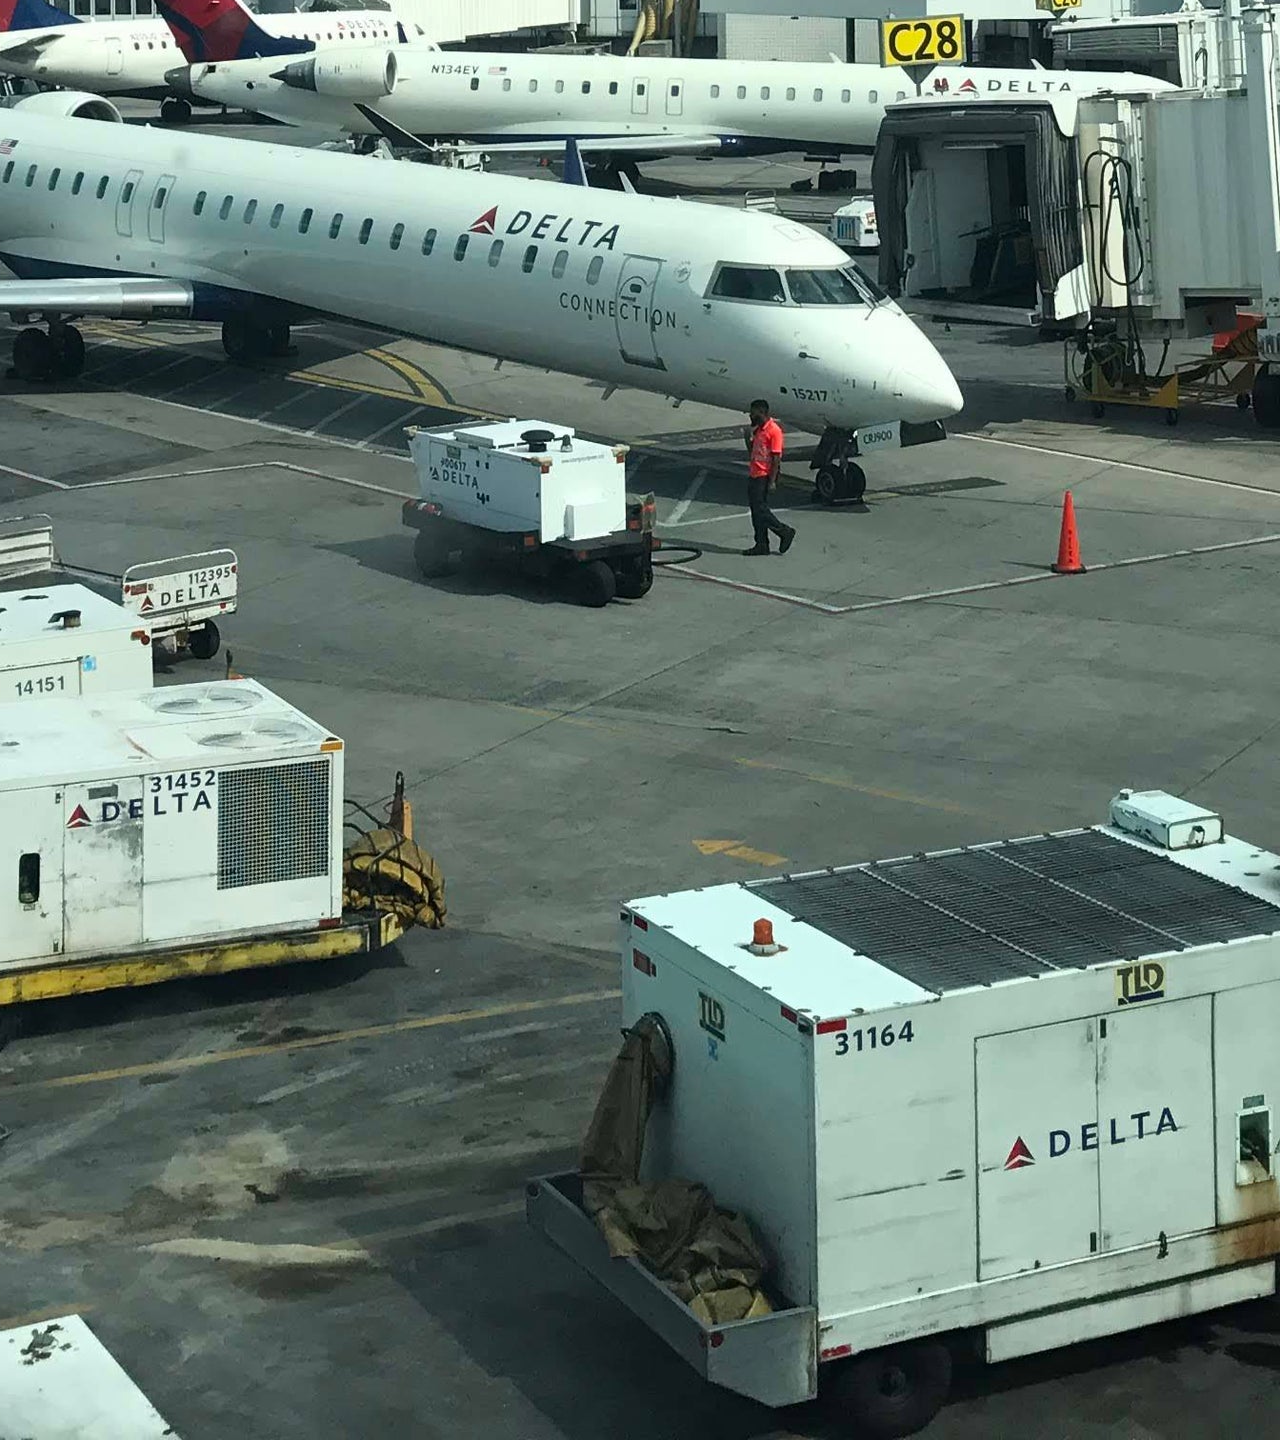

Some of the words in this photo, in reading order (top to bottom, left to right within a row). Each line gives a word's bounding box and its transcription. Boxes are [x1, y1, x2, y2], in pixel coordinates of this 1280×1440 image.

[888, 20, 958, 61] C28
[431, 64, 480, 75] N134EV
[988, 79, 1072, 93] DELTA
[505, 210, 620, 250] DELTA
[559, 292, 677, 329] CONNECTION
[792, 388, 828, 402] 15217
[442, 469, 479, 489] DELTA
[189, 566, 231, 584] 112395
[161, 582, 221, 606] DELTA
[15, 675, 65, 696] 14151
[150, 770, 216, 793] 31452
[102, 790, 212, 823] DELTA
[1117, 963, 1164, 1003] TLD
[698, 991, 725, 1032] TLD
[835, 1020, 914, 1056] 31164
[1049, 1107, 1178, 1158] DELTA
